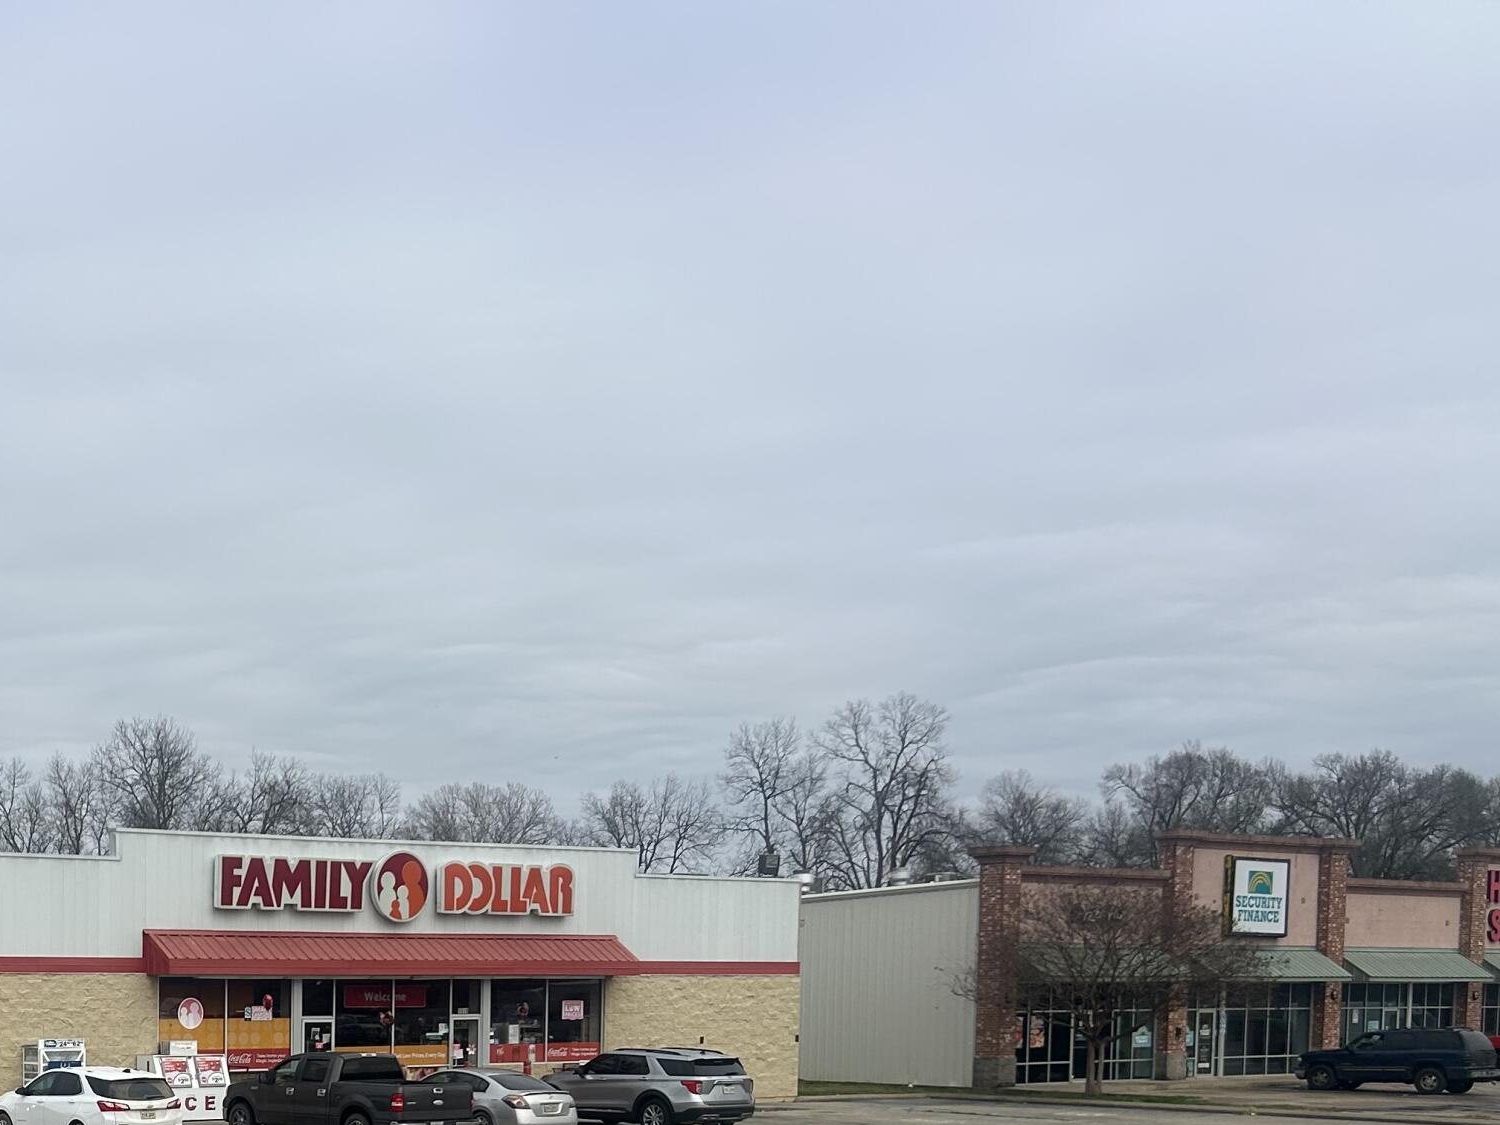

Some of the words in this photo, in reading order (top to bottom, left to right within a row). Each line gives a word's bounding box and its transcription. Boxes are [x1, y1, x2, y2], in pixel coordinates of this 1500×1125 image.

[220, 856, 373, 910] FAMILY
[443, 863, 573, 914] DOLLAR
[1235, 895, 1283, 910] SECURITY
[1237, 909, 1280, 923] FINANCE
[364, 991, 406, 1001] Welcme
